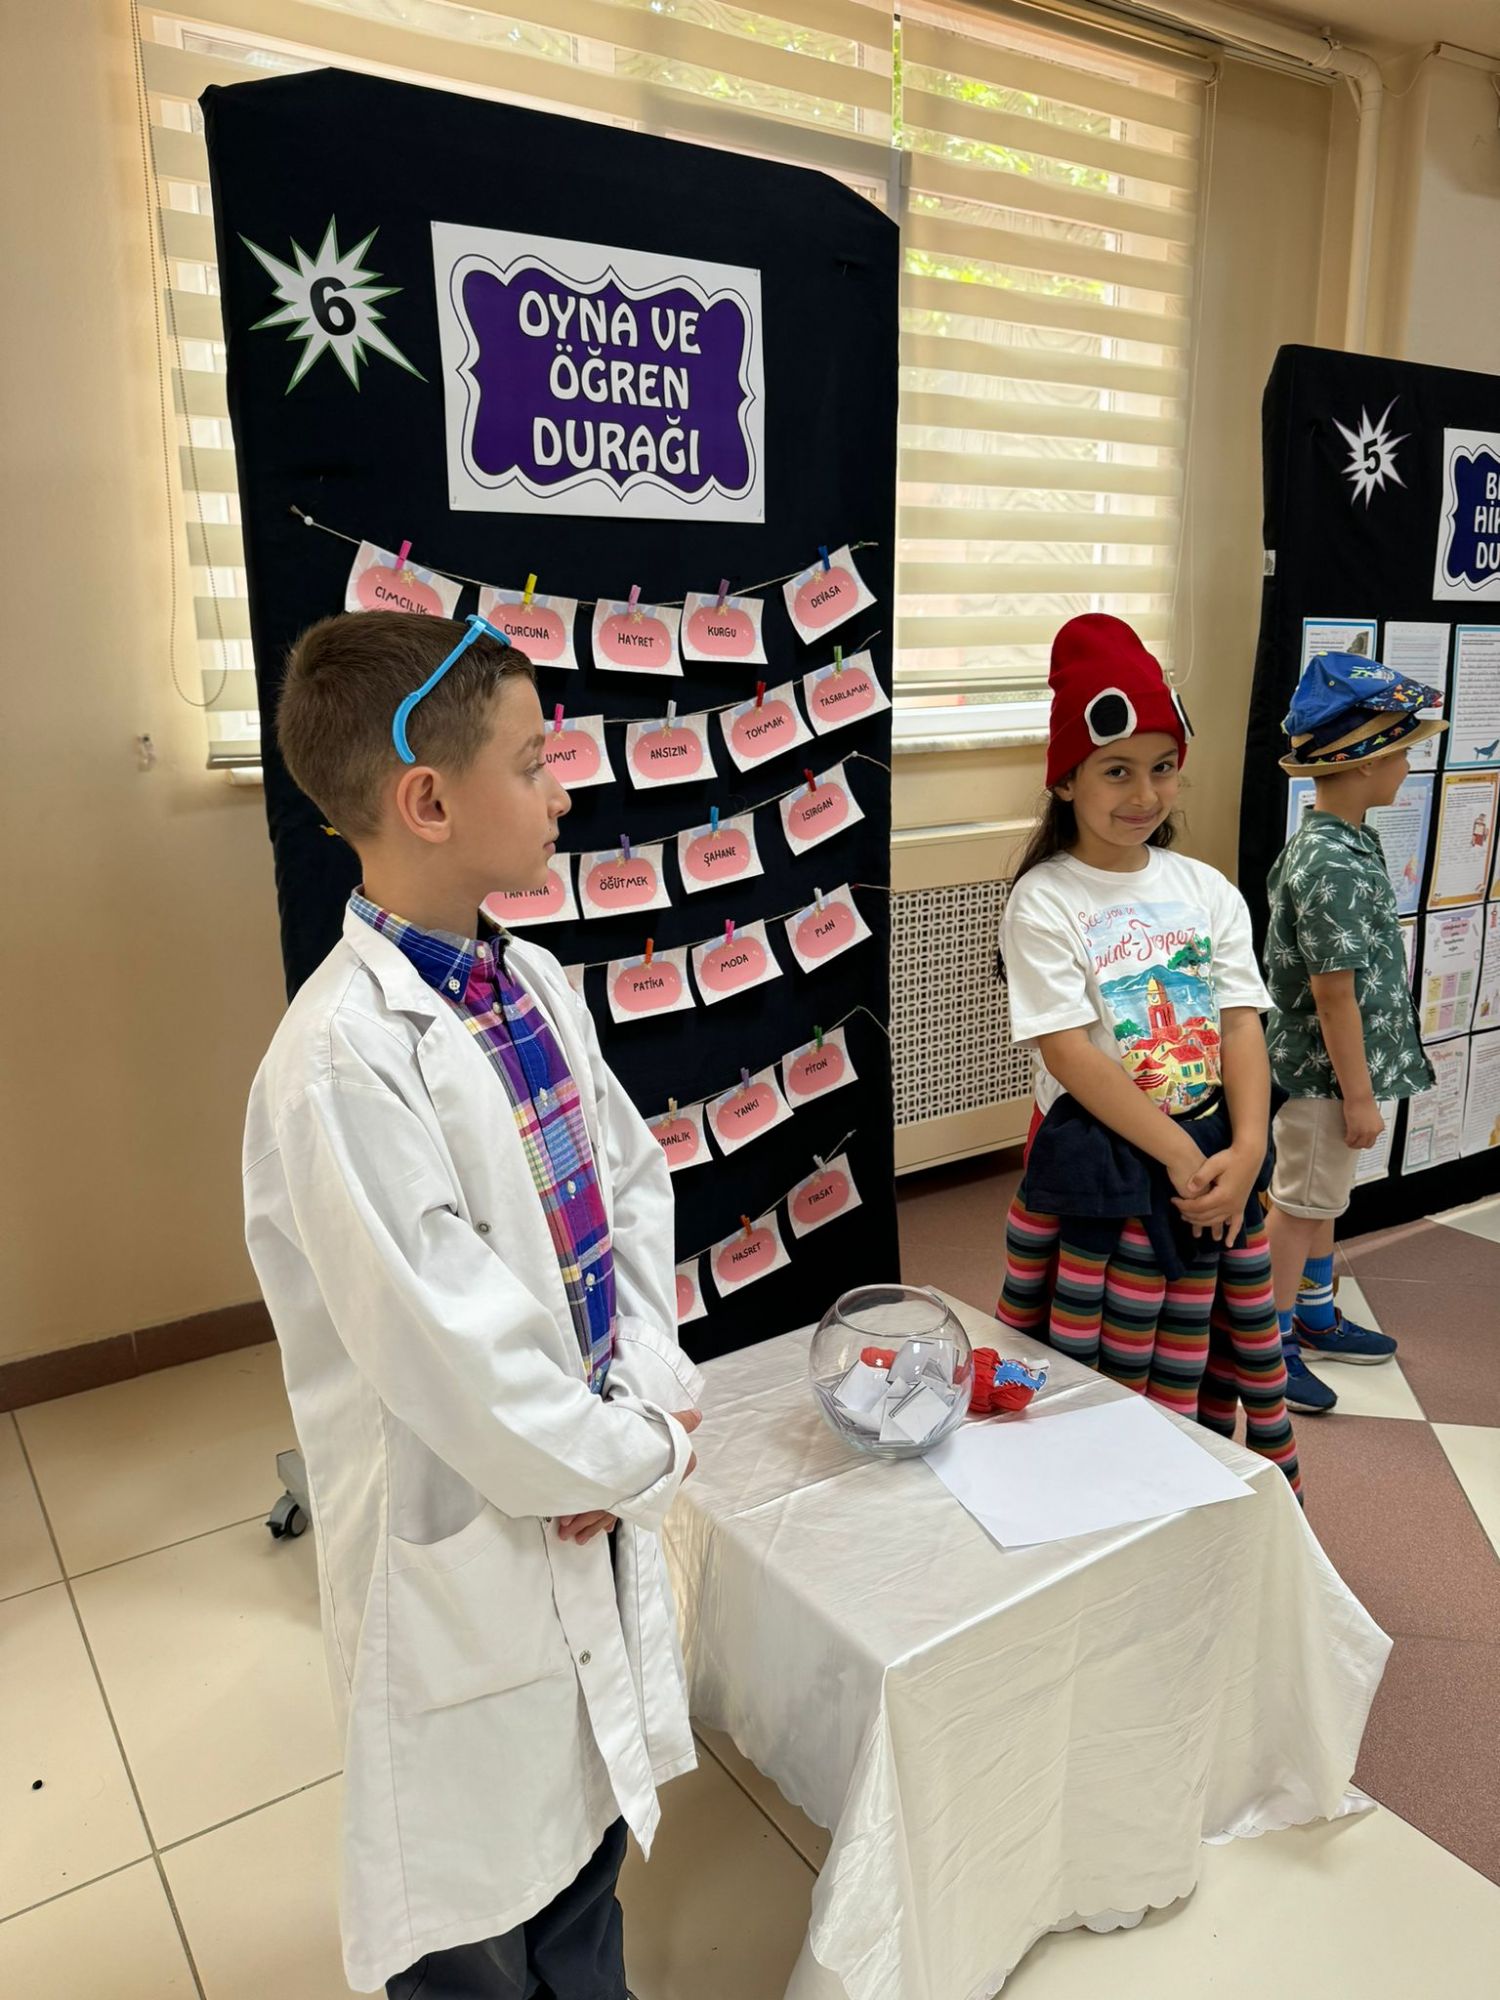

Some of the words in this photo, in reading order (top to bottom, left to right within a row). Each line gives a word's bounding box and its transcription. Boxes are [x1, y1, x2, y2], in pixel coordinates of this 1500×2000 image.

[309, 276, 357, 336] 6
[518, 290, 639, 348] OYNA
[651, 306, 702, 355] VE
[549, 343, 689, 410] ÖĞREN
[533, 414, 700, 476] DURAĞI
[1362, 438, 1381, 475] 5
[1486, 471, 1500, 500] B
[375, 585, 428, 614] CIMCILIK
[811, 585, 842, 609] DEVASA
[504, 624, 550, 639] CURCUNA
[617, 633, 654, 648] HAYRET
[707, 626, 737, 638] KURGU
[819, 682, 870, 707] TASARLAMAK
[745, 716, 785, 740] TOKMAK
[545, 749, 577, 764] UMUT
[650, 745, 688, 760] ANSIZIN
[802, 797, 834, 822] ISIRGAN
[703, 846, 737, 867] ŞAHANE
[599, 876, 649, 891] ÖĞÜTMEK
[814, 919, 836, 938] PLAN
[1078, 911, 1102, 934] See
[720, 953, 750, 972] MODA
[633, 976, 665, 992] PATİKA
[804, 1058, 828, 1076] PİTON
[807, 1185, 834, 1205] FIRSAT
[731, 1242, 761, 1263] HASRET
